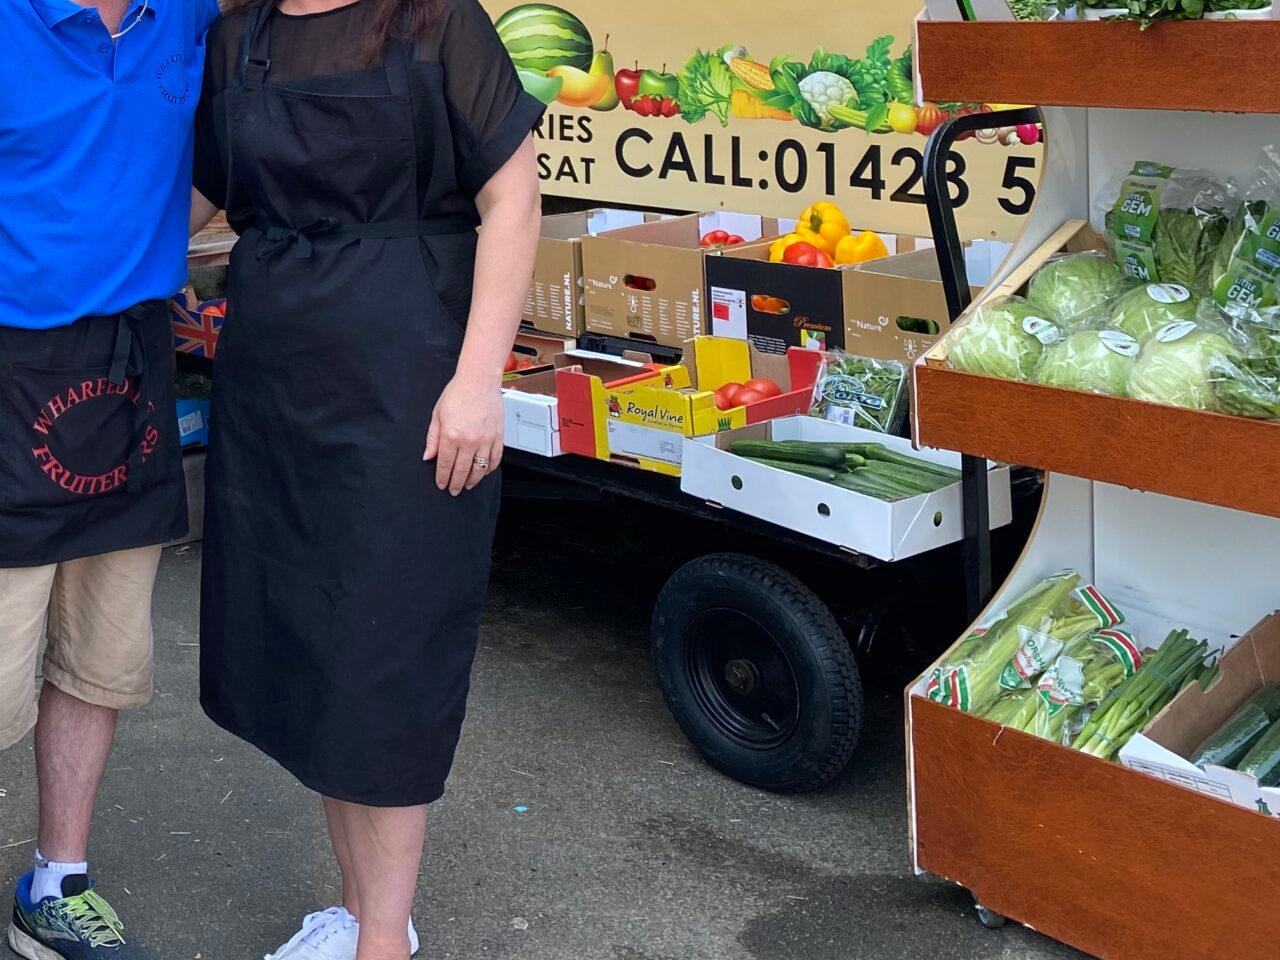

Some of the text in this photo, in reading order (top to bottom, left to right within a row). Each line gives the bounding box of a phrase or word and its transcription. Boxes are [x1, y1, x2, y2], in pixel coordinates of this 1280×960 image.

[537, 153, 595, 185] SAT
[997, 156, 1036, 215] 5
[1121, 199, 1152, 217] GEM
[593, 280, 613, 290] Nature
[563, 271, 572, 330] NATURE.NL
[856, 320, 882, 332] Nature
[626, 402, 684, 424] Royal Vine
